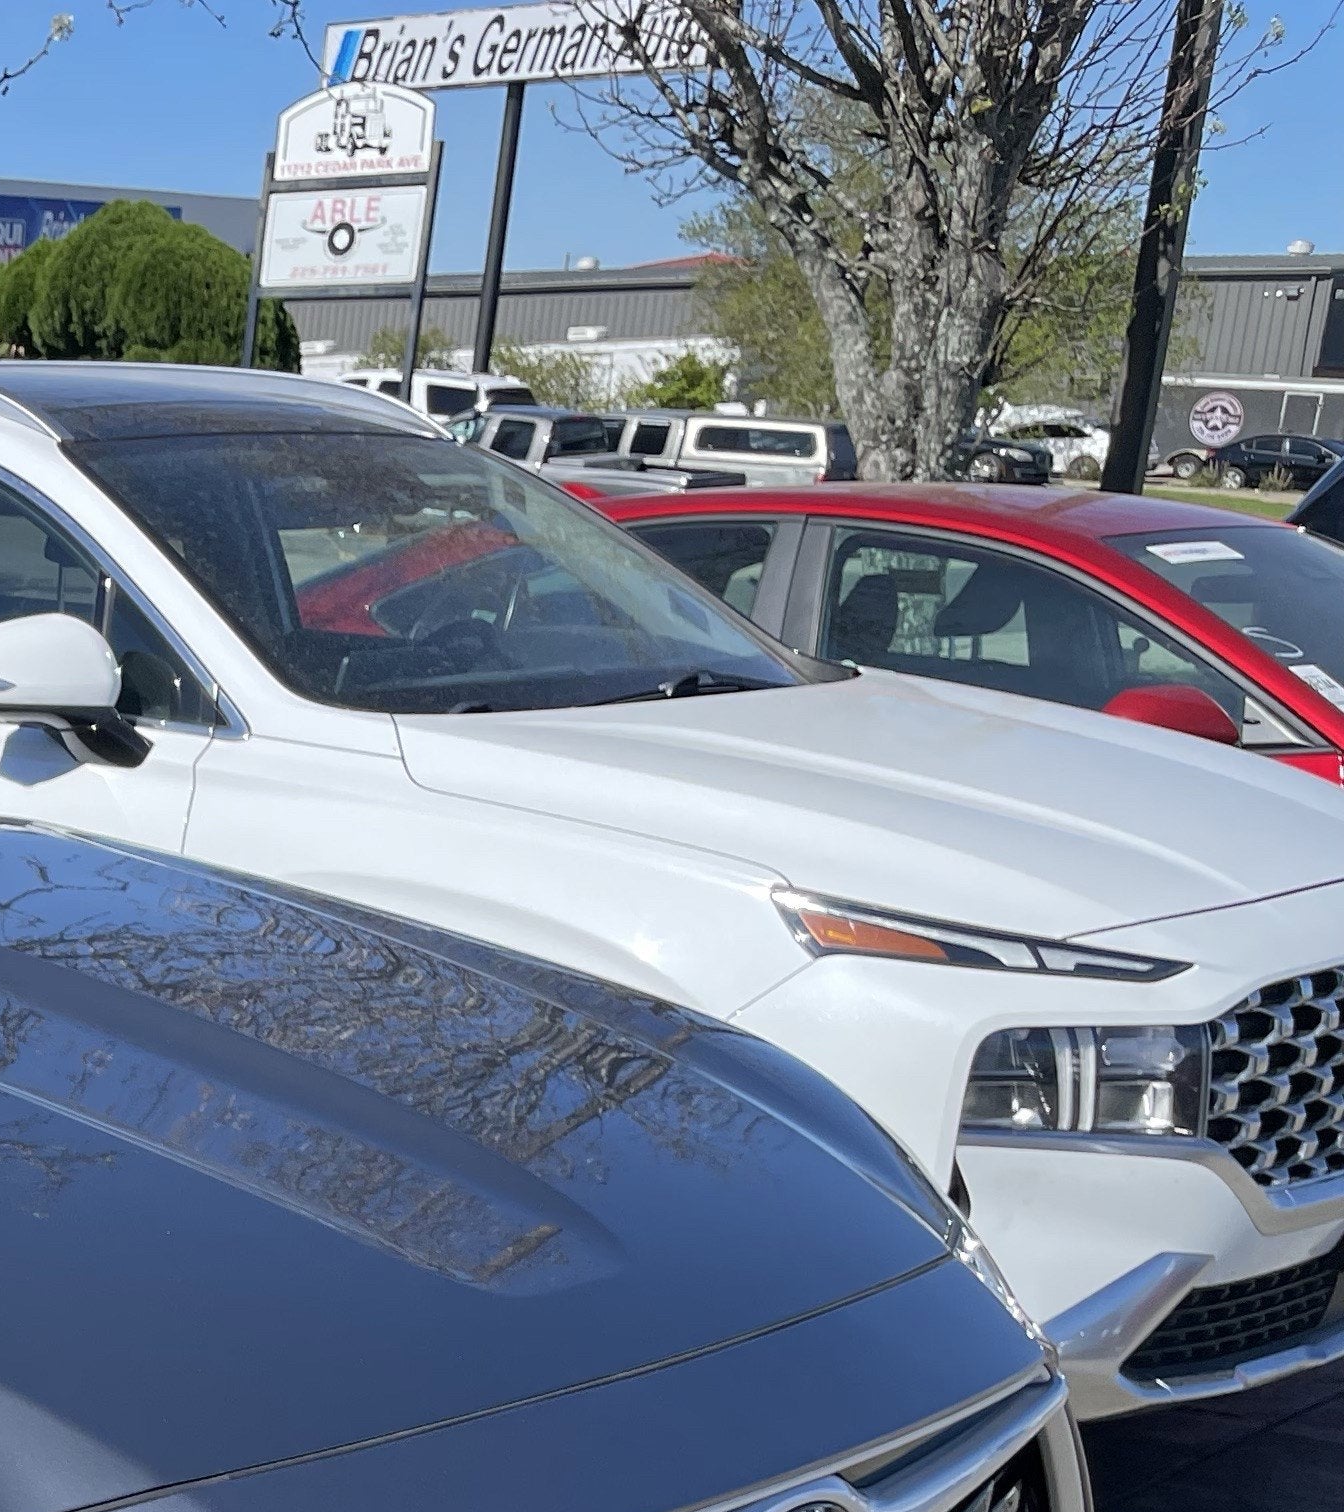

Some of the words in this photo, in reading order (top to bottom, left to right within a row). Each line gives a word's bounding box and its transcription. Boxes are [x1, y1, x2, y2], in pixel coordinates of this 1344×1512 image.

[350, 20, 466, 84] Brian's
[472, 13, 609, 77] German
[310, 194, 381, 224] ABLE
